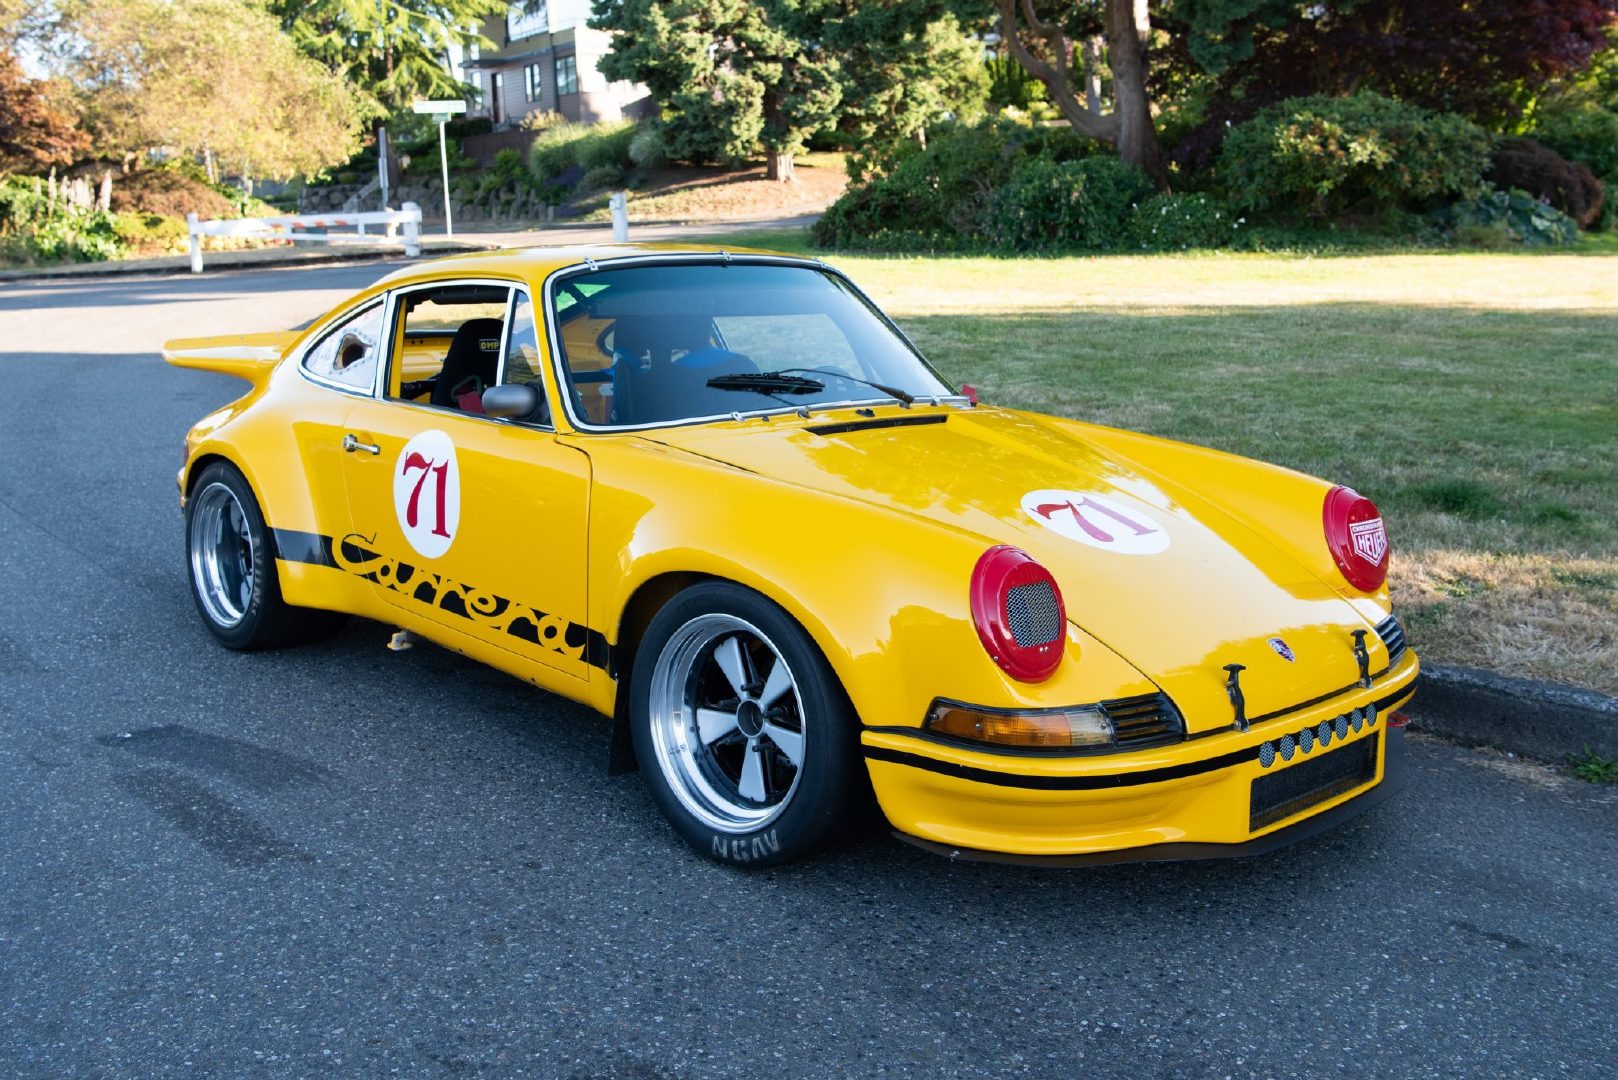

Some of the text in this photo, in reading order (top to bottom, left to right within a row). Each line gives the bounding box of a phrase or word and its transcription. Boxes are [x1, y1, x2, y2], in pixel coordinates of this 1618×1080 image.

[480, 341, 500, 350] OMP
[403, 452, 451, 539] 71
[1030, 497, 1158, 542] 71
[1357, 530, 1386, 560] HEUER
[331, 532, 588, 660] Carrera
[712, 829, 780, 861] AVON
